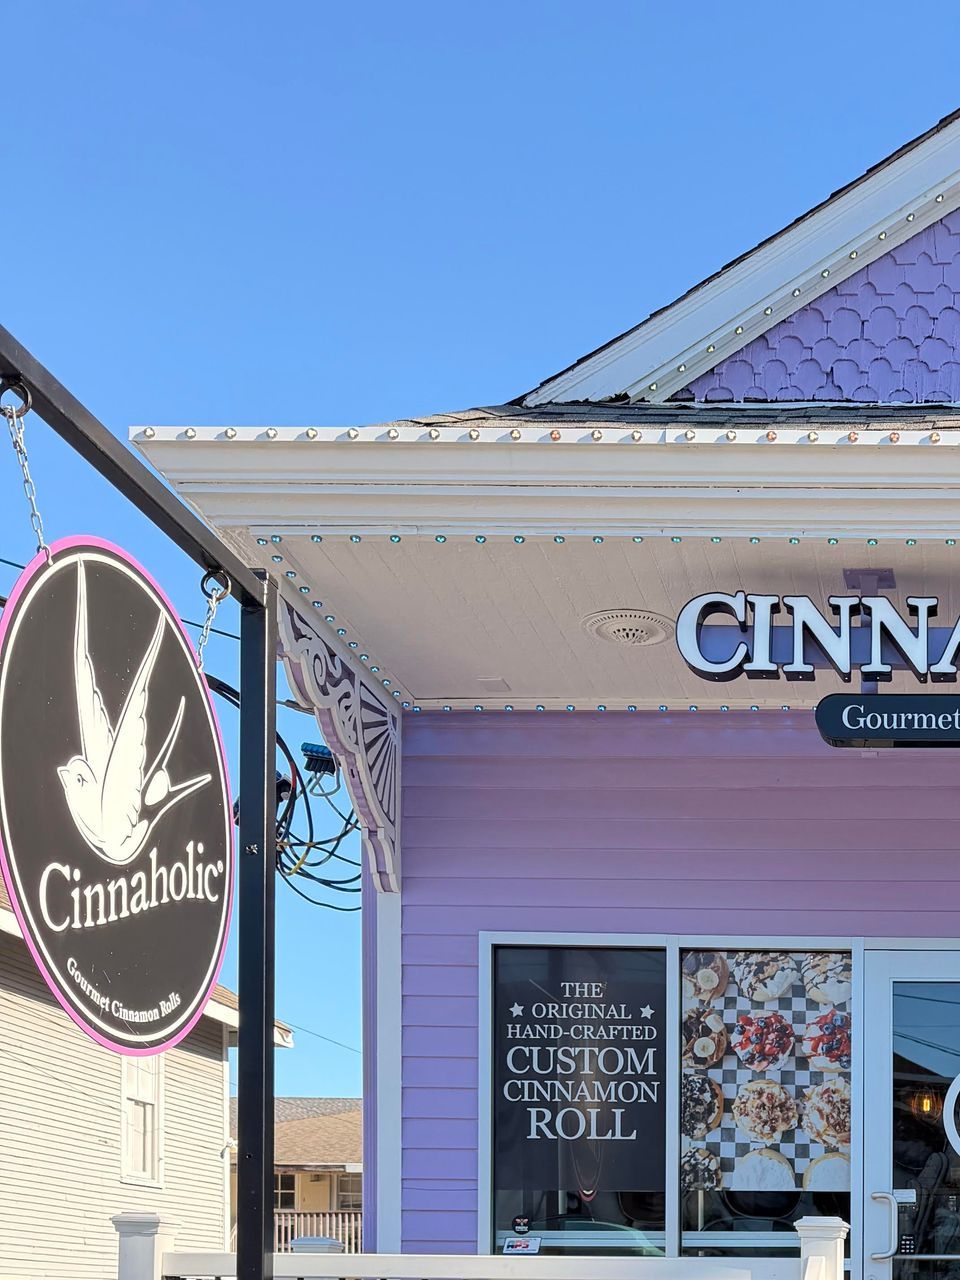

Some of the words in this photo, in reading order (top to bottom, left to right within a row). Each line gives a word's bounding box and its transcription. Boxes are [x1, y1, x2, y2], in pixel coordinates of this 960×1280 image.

[66, 957, 110, 1012] Gourmet
[111, 1000, 160, 1023] Cinnamon
[159, 991, 181, 1018] Rolls
[560, 982, 604, 998] THE
[531, 1003, 632, 1020] ORIGINAL
[506, 1023, 658, 1040] HAND-CRAFTED
[506, 1045, 657, 1075] CUSTOM
[503, 1079, 660, 1103] CINNAMON
[526, 1107, 637, 1140] ROLL
